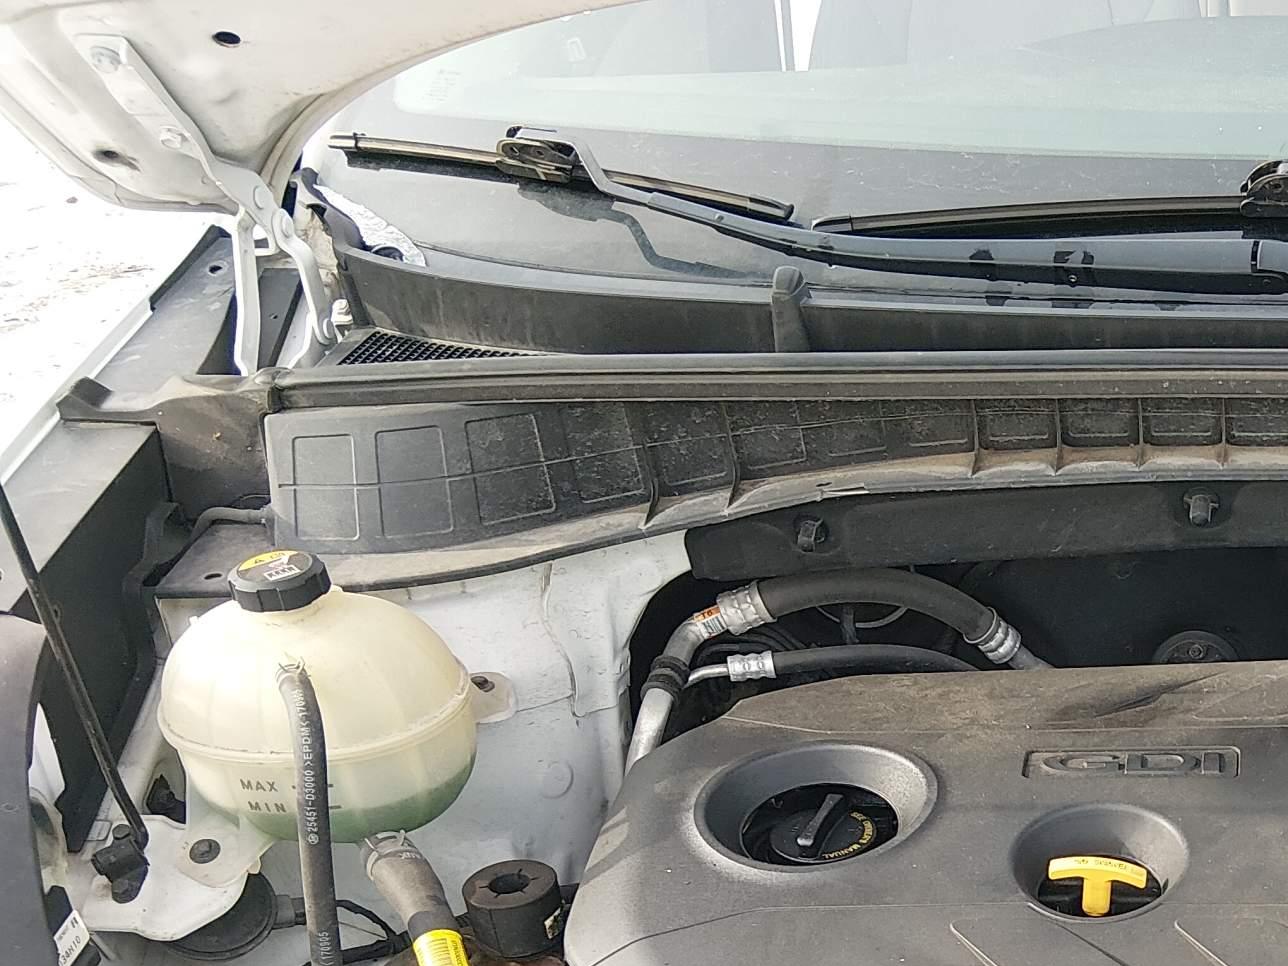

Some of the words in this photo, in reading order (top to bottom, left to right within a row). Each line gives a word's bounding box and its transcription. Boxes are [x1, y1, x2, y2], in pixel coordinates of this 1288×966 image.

[1040, 752, 1224, 775] GDI
[239, 778, 279, 792] MAX
[248, 800, 287, 813] MIN
